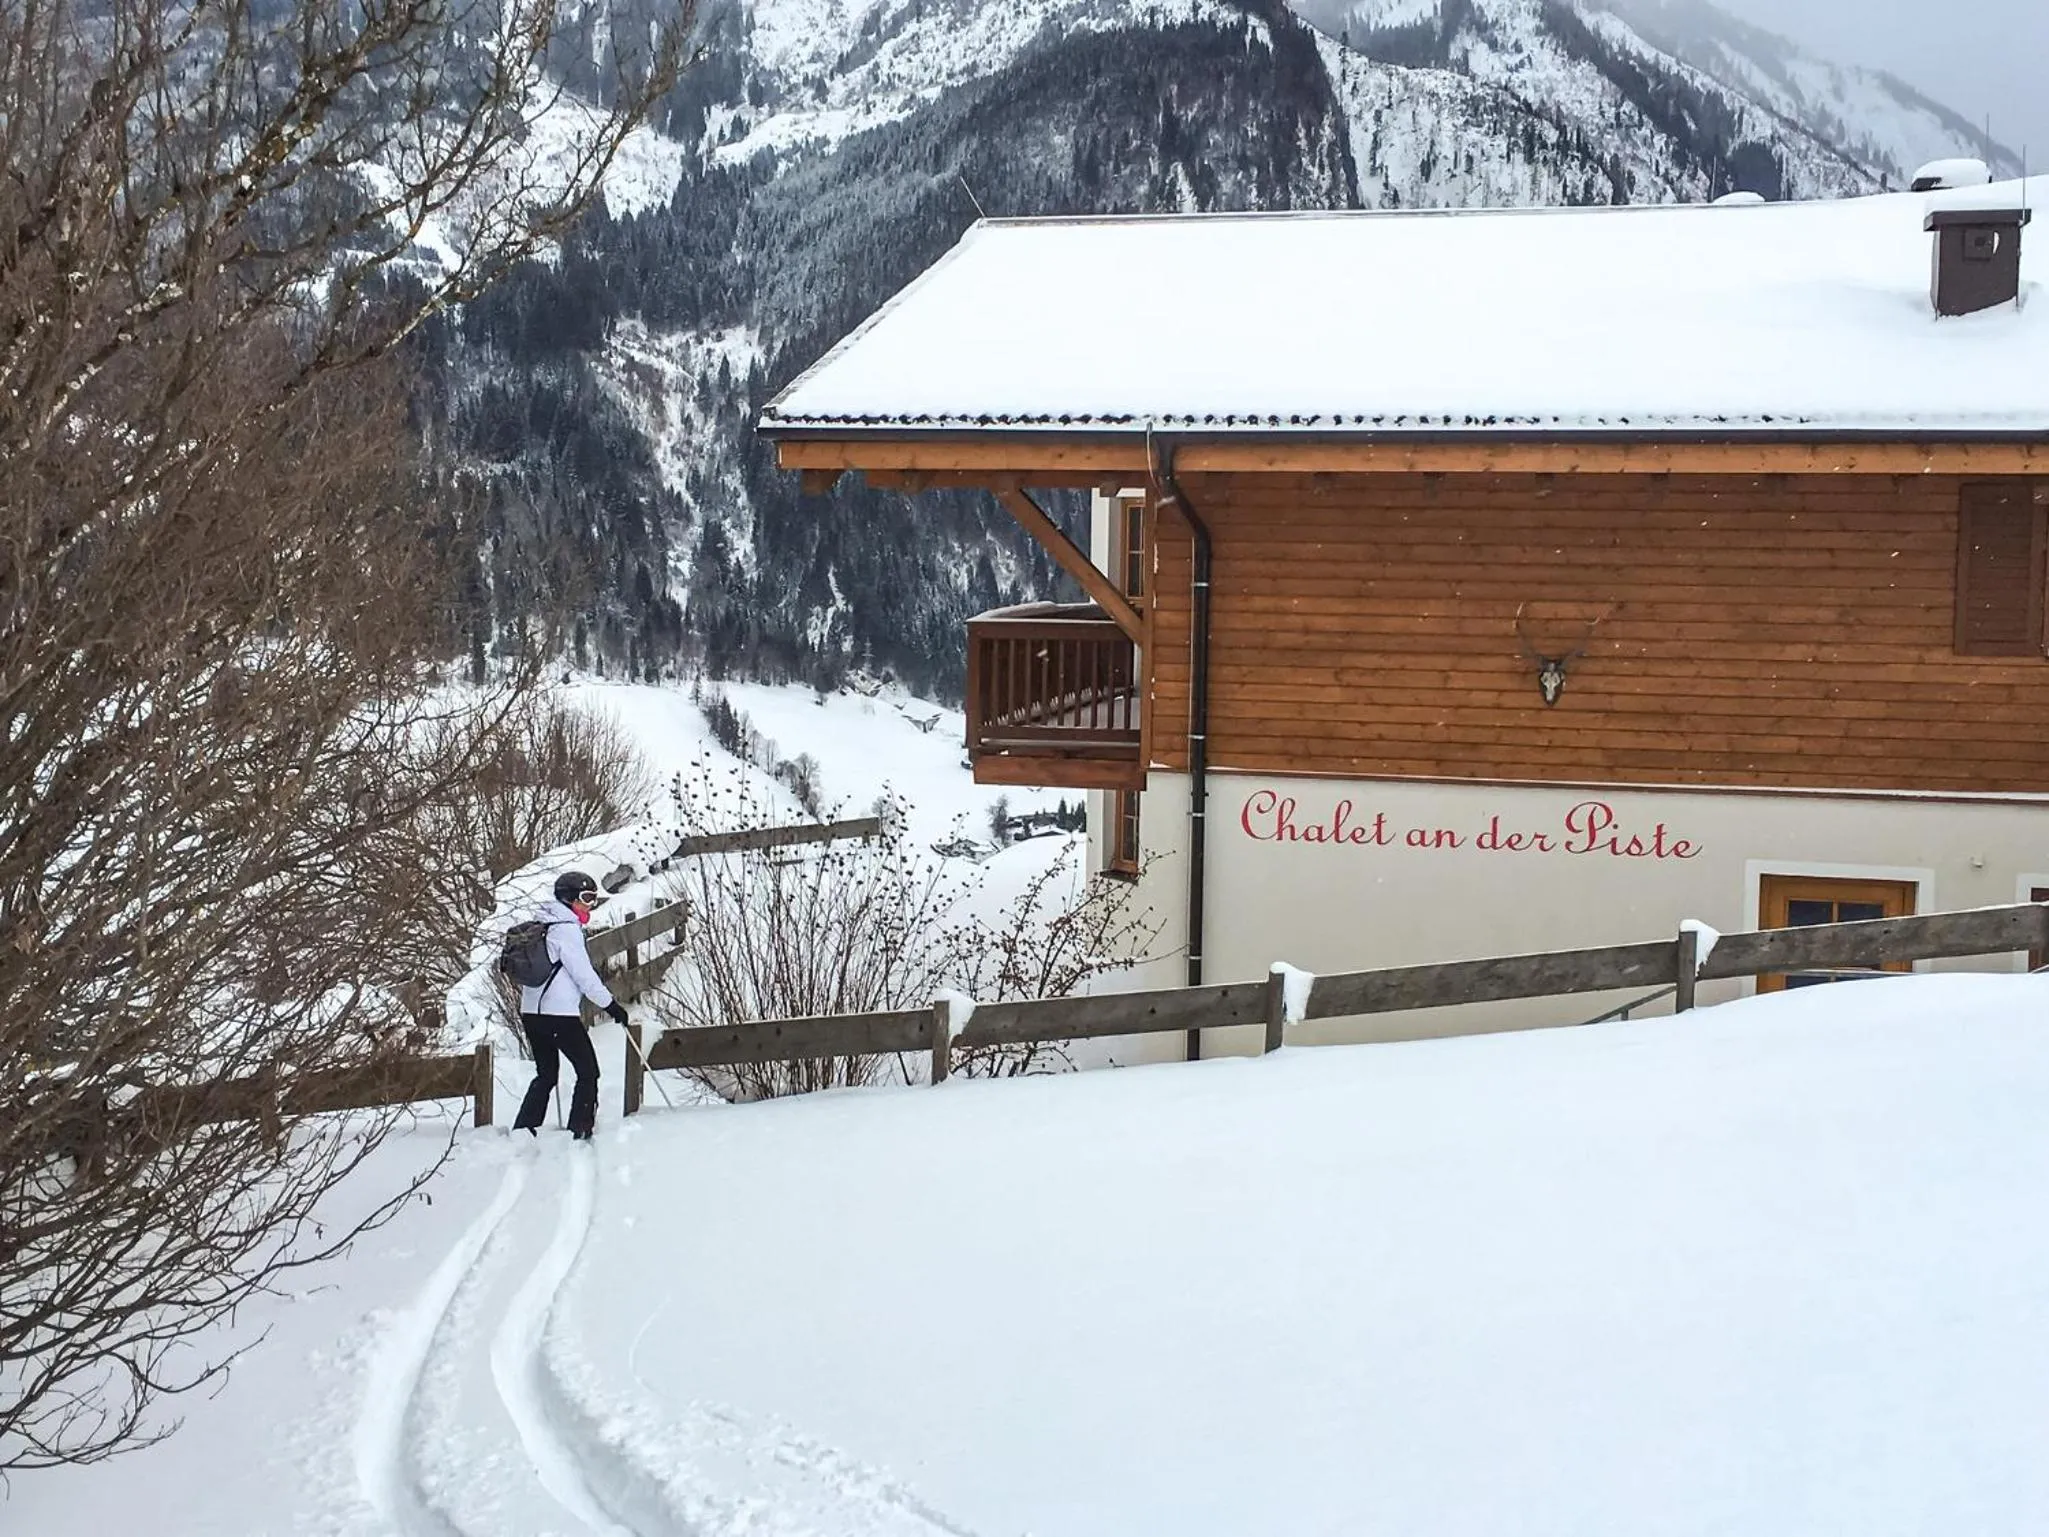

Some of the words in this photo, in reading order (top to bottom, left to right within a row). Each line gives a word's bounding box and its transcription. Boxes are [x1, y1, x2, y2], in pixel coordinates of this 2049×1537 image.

[1240, 789, 1395, 847] Chalet
[1405, 828, 1468, 850] an
[1475, 814, 1557, 852] der
[1564, 800, 1703, 859] Piste
